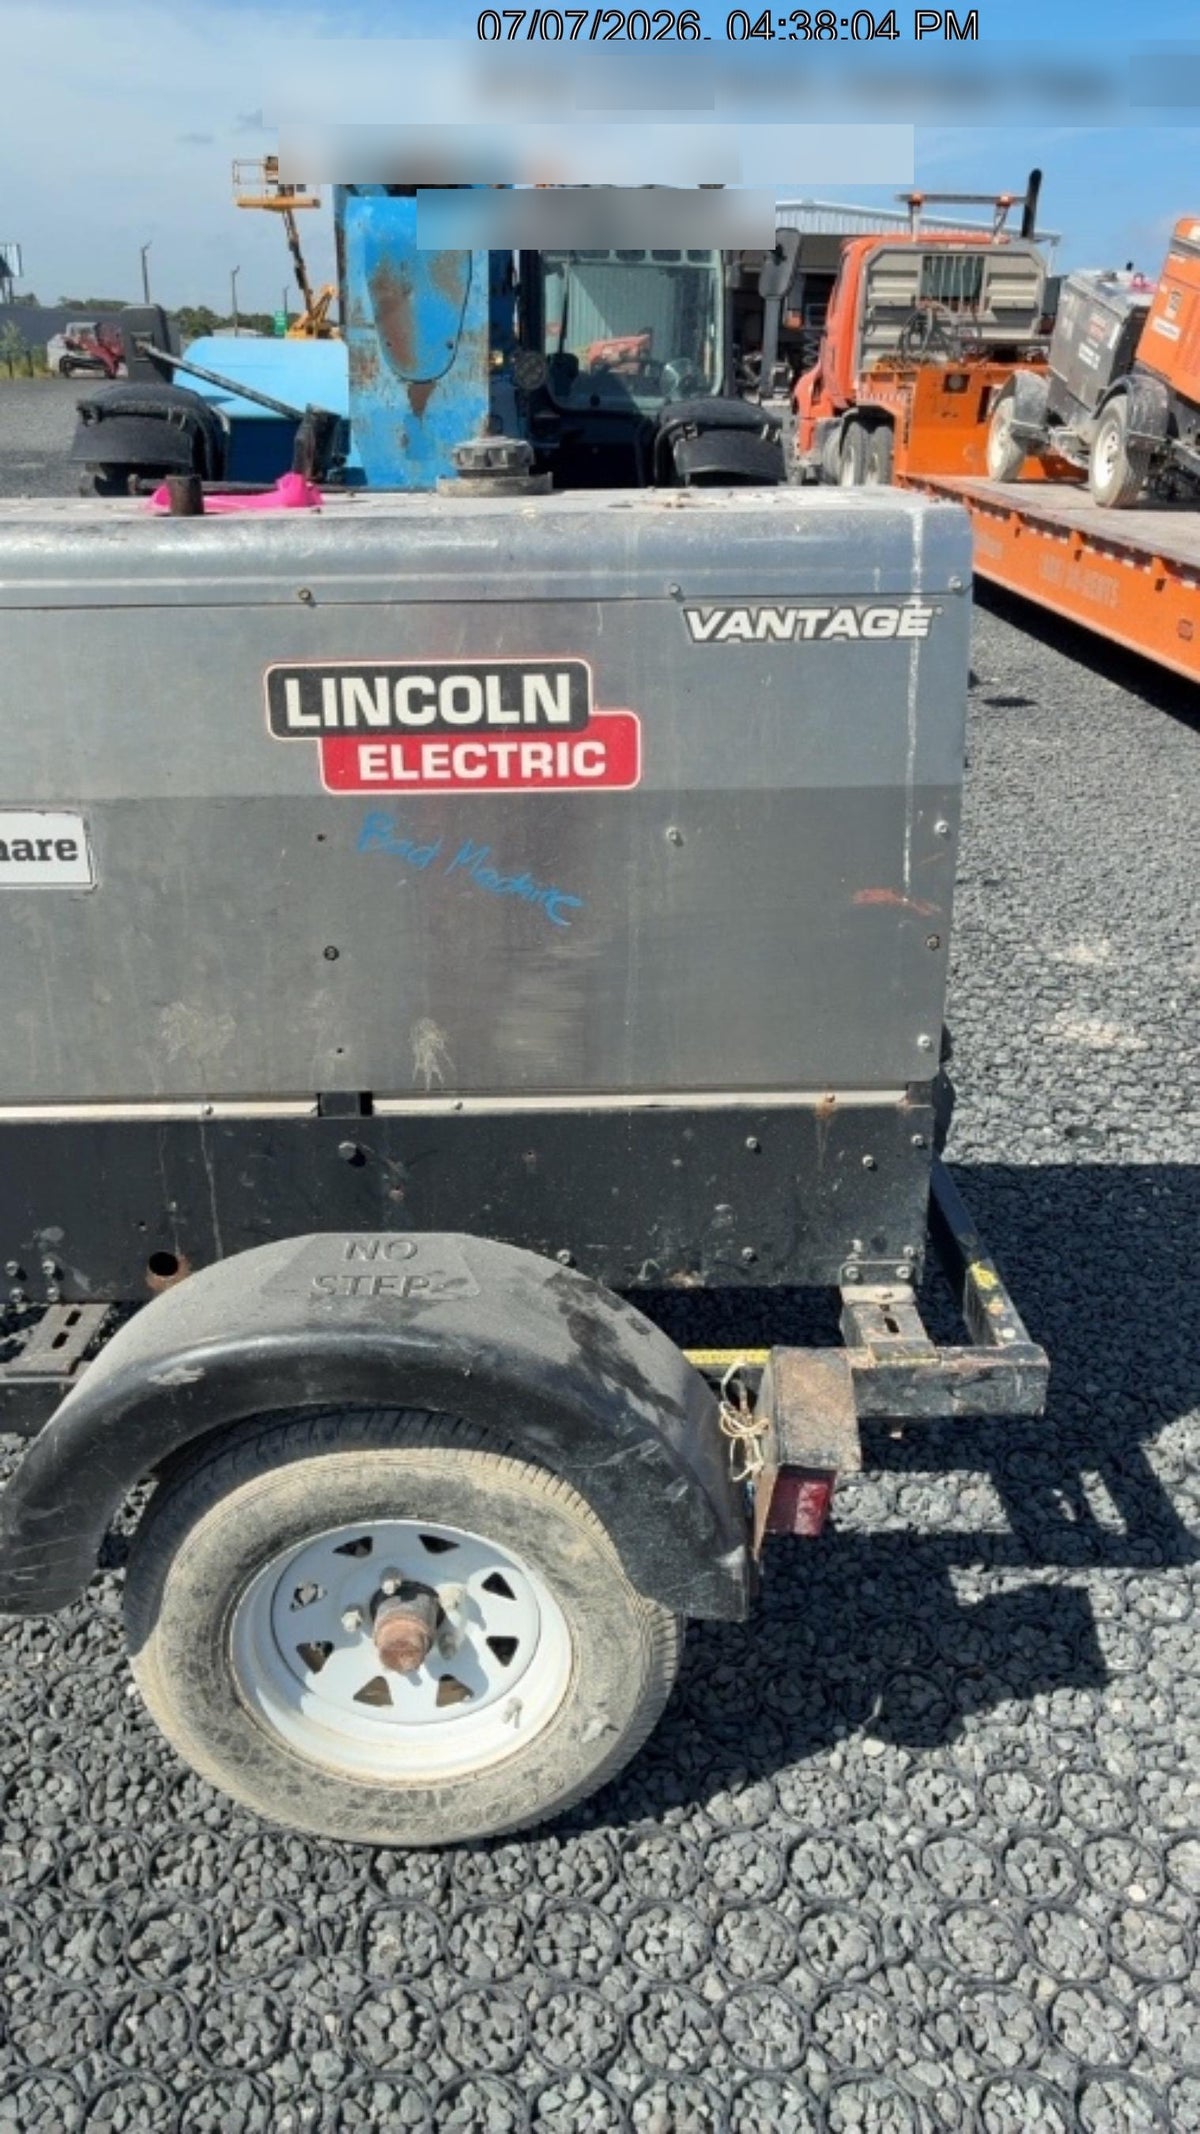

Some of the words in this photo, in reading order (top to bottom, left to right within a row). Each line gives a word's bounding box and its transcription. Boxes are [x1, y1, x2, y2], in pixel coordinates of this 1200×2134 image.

[686, 606, 935, 641] VANTAGE
[284, 673, 571, 727] LINCOLN
[357, 741, 607, 781] ELECTRIC
[343, 1239, 419, 1261] NO
[312, 1275, 430, 1298] STEP
